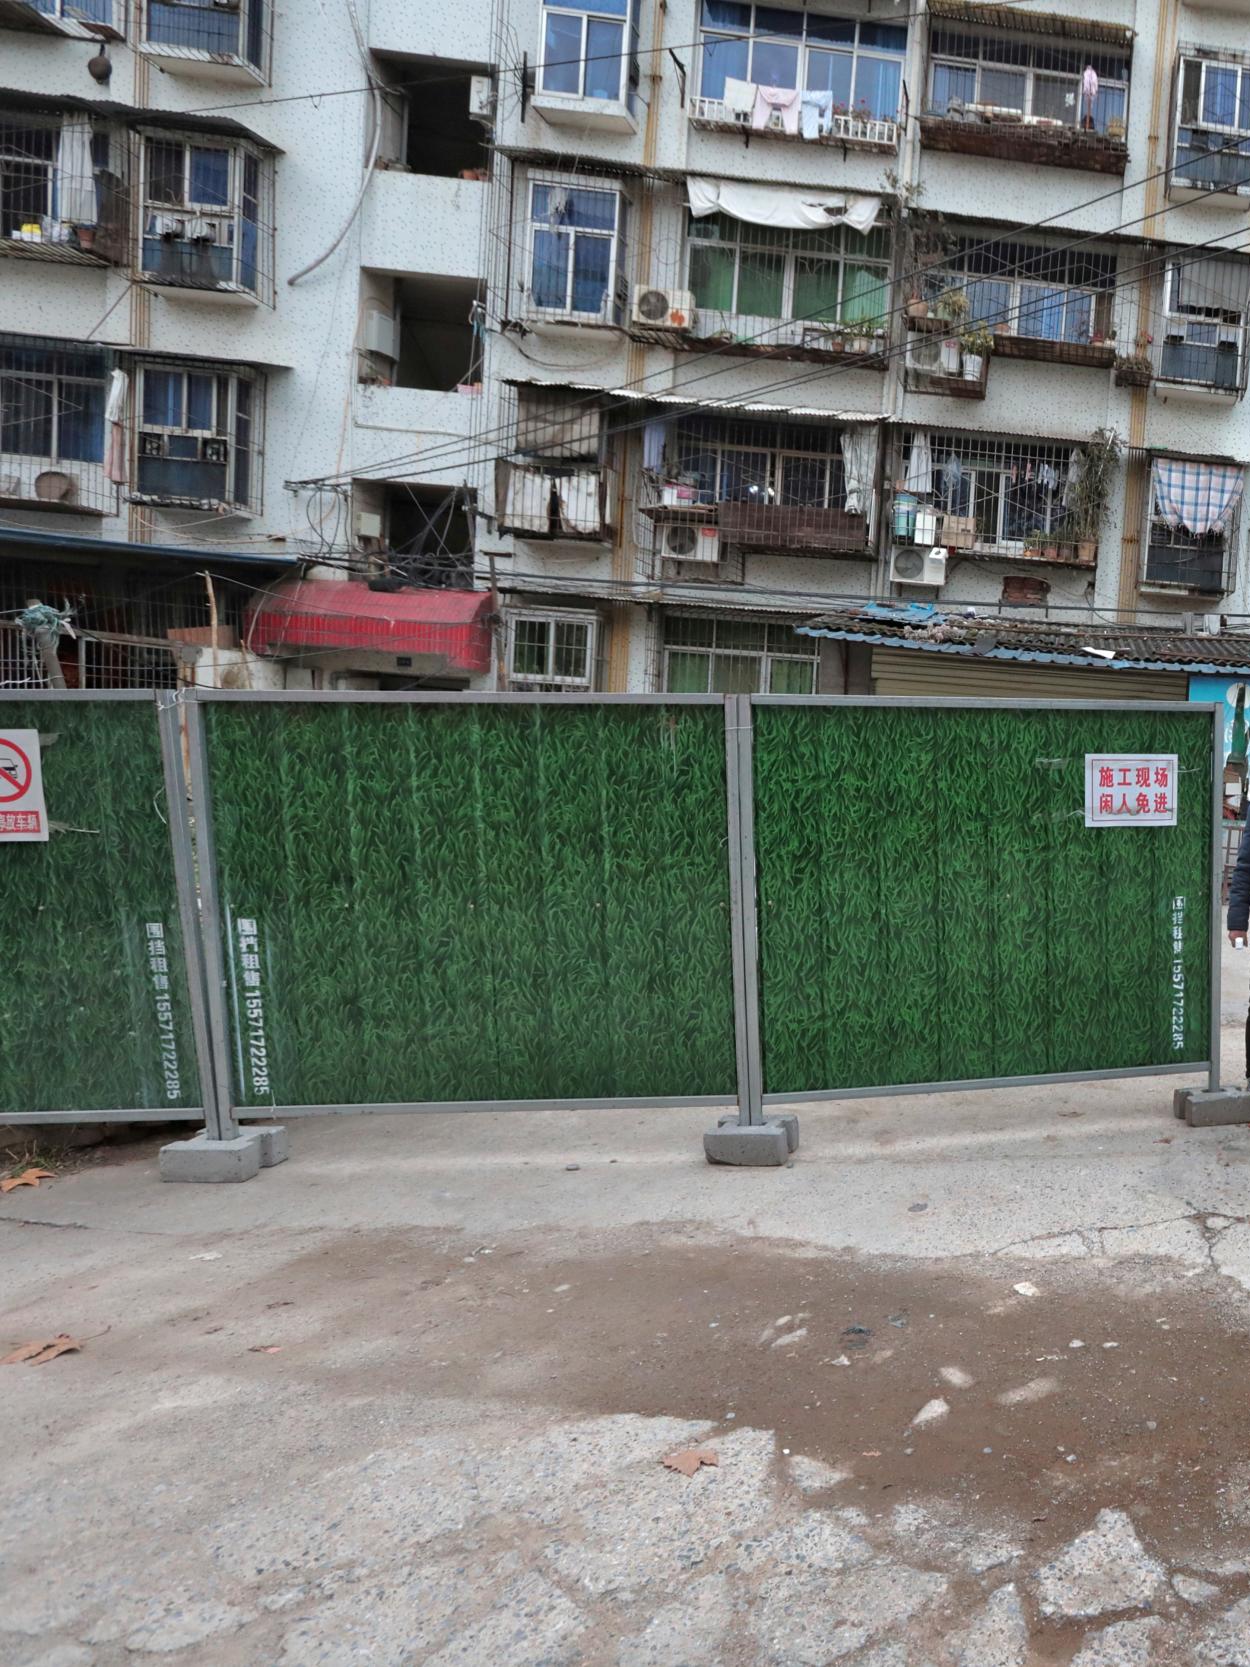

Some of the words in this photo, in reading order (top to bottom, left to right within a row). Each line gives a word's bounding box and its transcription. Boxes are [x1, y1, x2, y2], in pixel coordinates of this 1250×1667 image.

[1099, 766, 1168, 788] 施工现场
[1099, 792, 1168, 814] 闲人免进
[155, 993, 181, 1100] 15571722285
[244, 990, 270, 1095] 15571722285
[1172, 959, 1184, 1050] 15571722285
